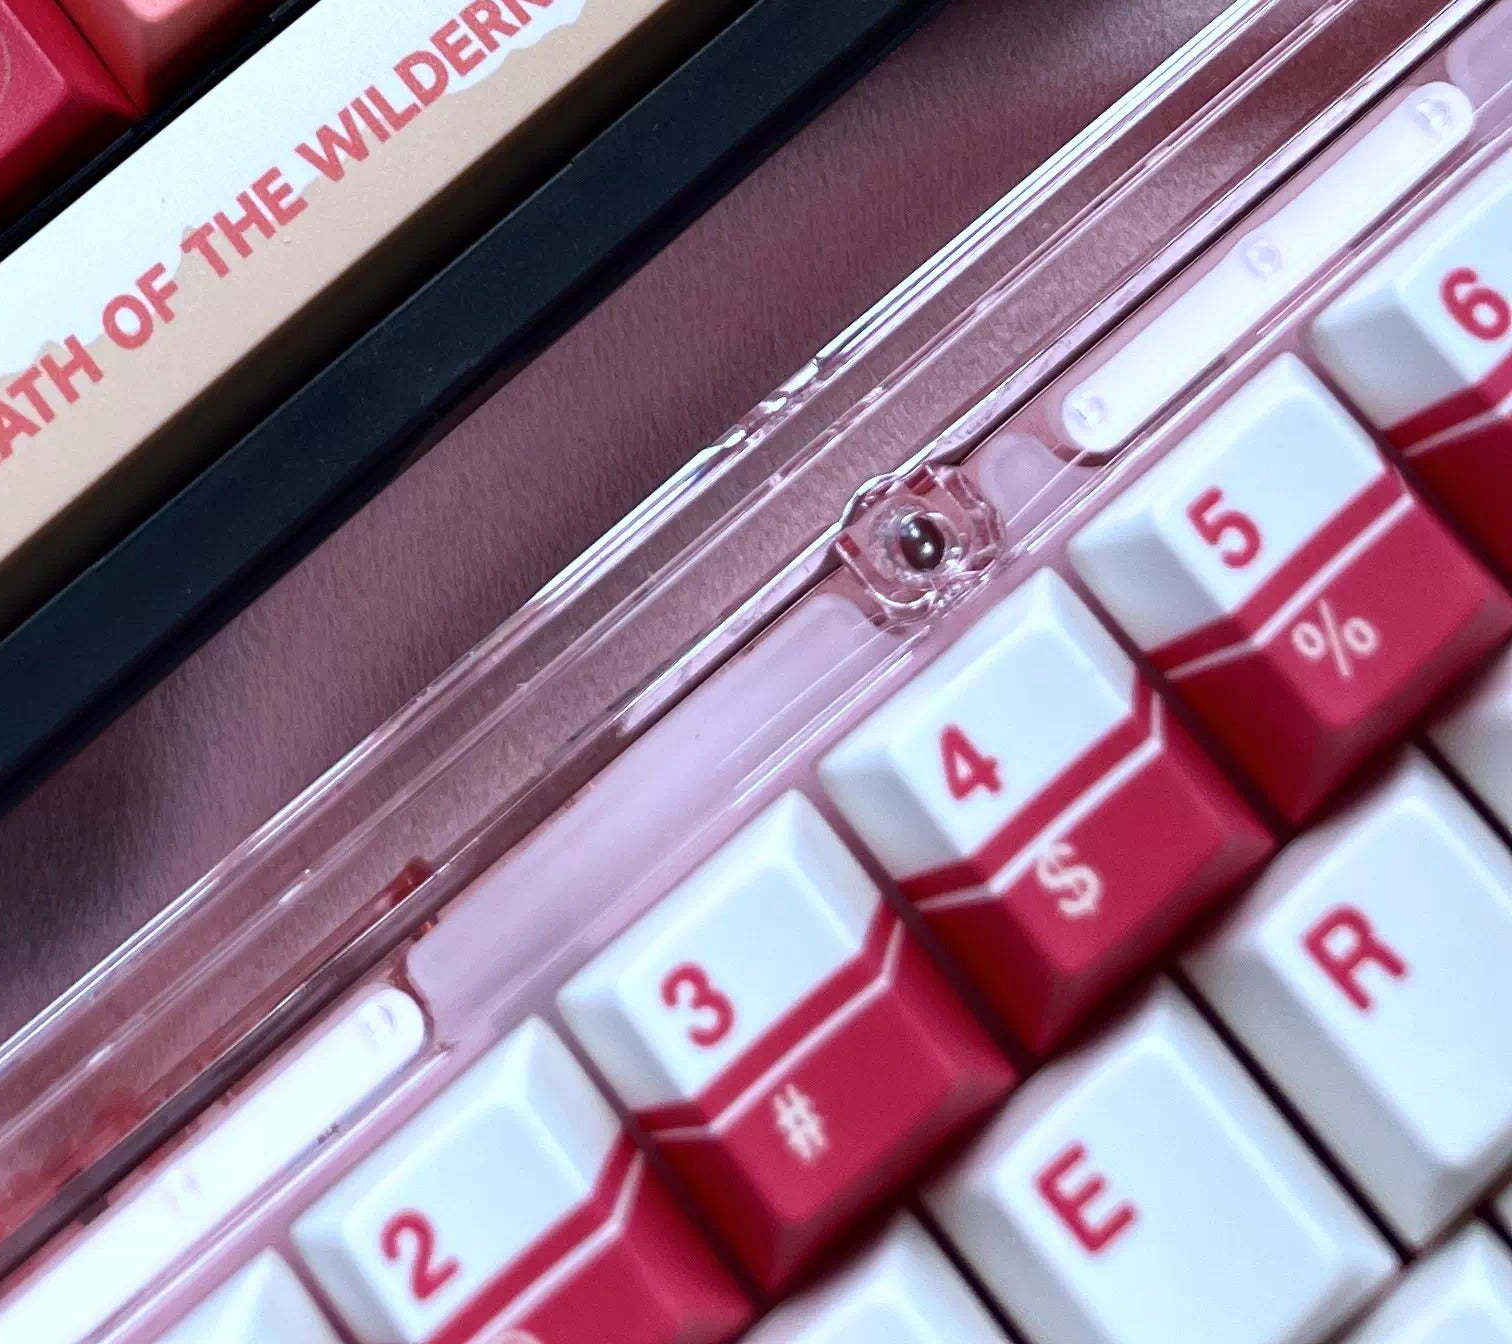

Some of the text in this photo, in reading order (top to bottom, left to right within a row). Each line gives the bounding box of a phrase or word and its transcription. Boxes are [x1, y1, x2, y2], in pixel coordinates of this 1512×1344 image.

[102, 263, 180, 350] OF
[180, 167, 308, 279] THE
[1440, 266, 1512, 342] 6
[1187, 486, 1262, 569] 5
[1292, 599, 1378, 680] %
[938, 724, 1002, 802] 4
[1036, 842, 1101, 919] $
[1301, 904, 1409, 1012] R
[660, 961, 735, 1048] 3
[771, 1083, 828, 1164] #
[1034, 1143, 1137, 1254] E
[379, 1208, 459, 1301] 2
